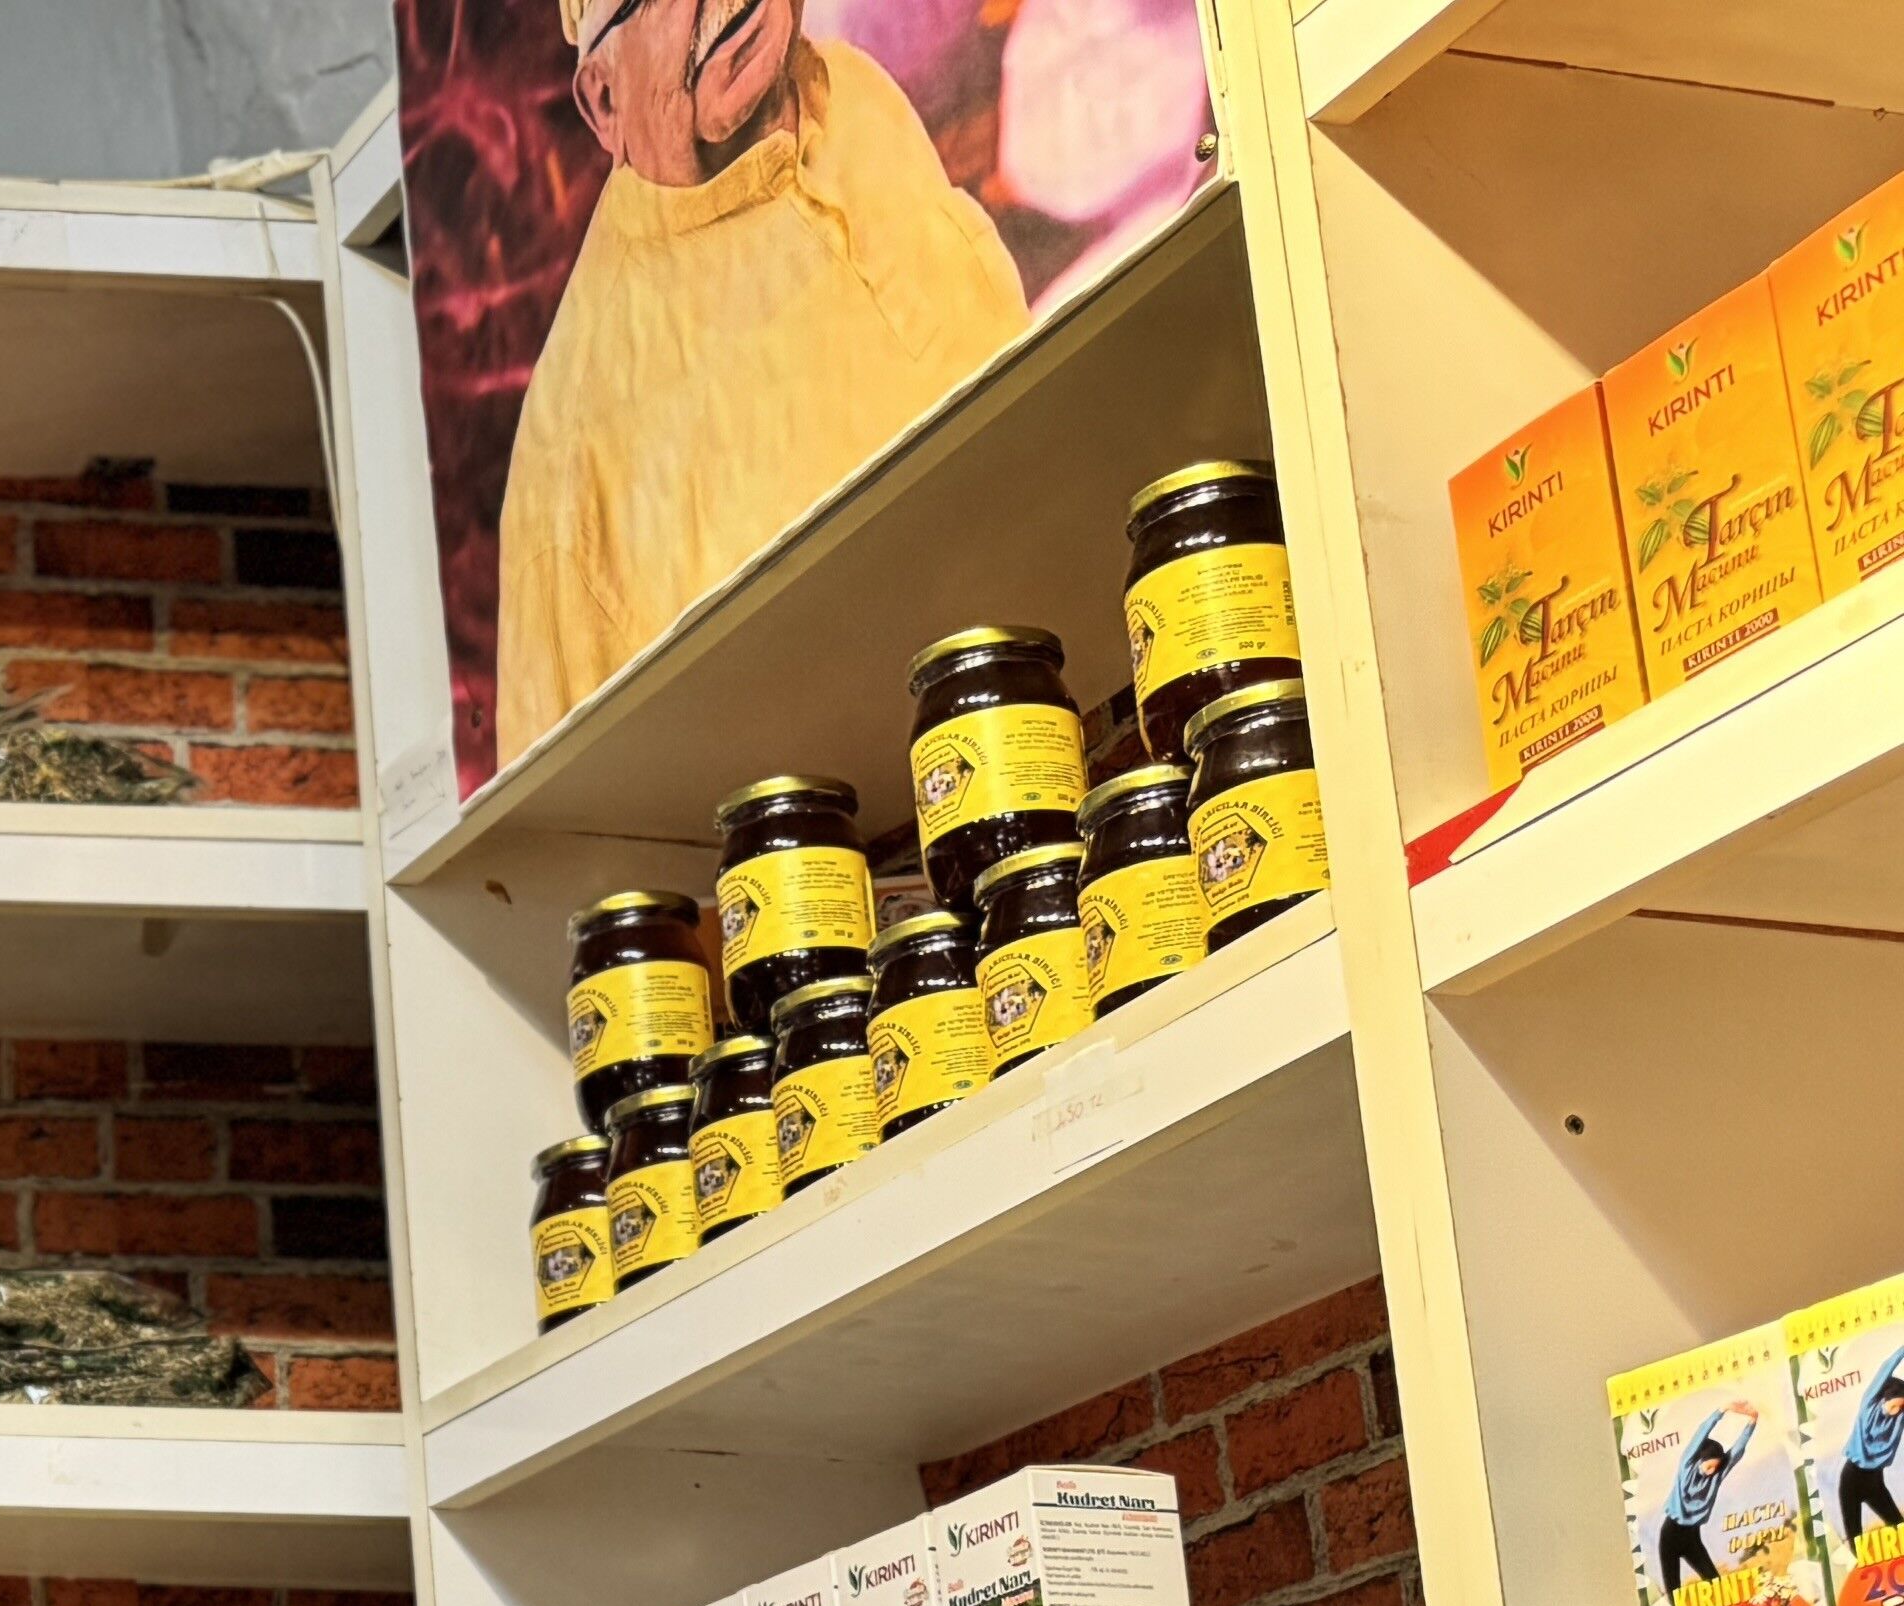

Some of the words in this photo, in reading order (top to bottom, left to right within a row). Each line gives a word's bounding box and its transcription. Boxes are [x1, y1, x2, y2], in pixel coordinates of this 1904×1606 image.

[1647, 364, 1735, 437] KIRINTI
[1488, 471, 1564, 538] KIRINTI
[1682, 473, 1795, 570] Tarçın
[1862, 534, 1904, 569] KIRIN
[1516, 575, 1621, 664] Tarçın
[1661, 613, 1713, 656] ПАСТА
[1719, 567, 1796, 621] КОРИЦЫ
[1687, 630, 1741, 670] KIRINTI
[1743, 611, 1774, 638] 2000
[1499, 710, 1546, 748] ПАСТА
[1550, 665, 1618, 718] КОРИЦЫ
[1805, 1370, 1861, 1401] KIRINTI
[1626, 1431, 1680, 1460] KIRINTI
[1057, 1492, 1115, 1507] Kudret
[1119, 1495, 1155, 1510] Narı
[965, 1511, 1019, 1548] KIRINTI
[1854, 1523, 1904, 1567] KIRI
[865, 1554, 916, 1589] KIRINTI
[999, 1570, 1031, 1593] Narı
